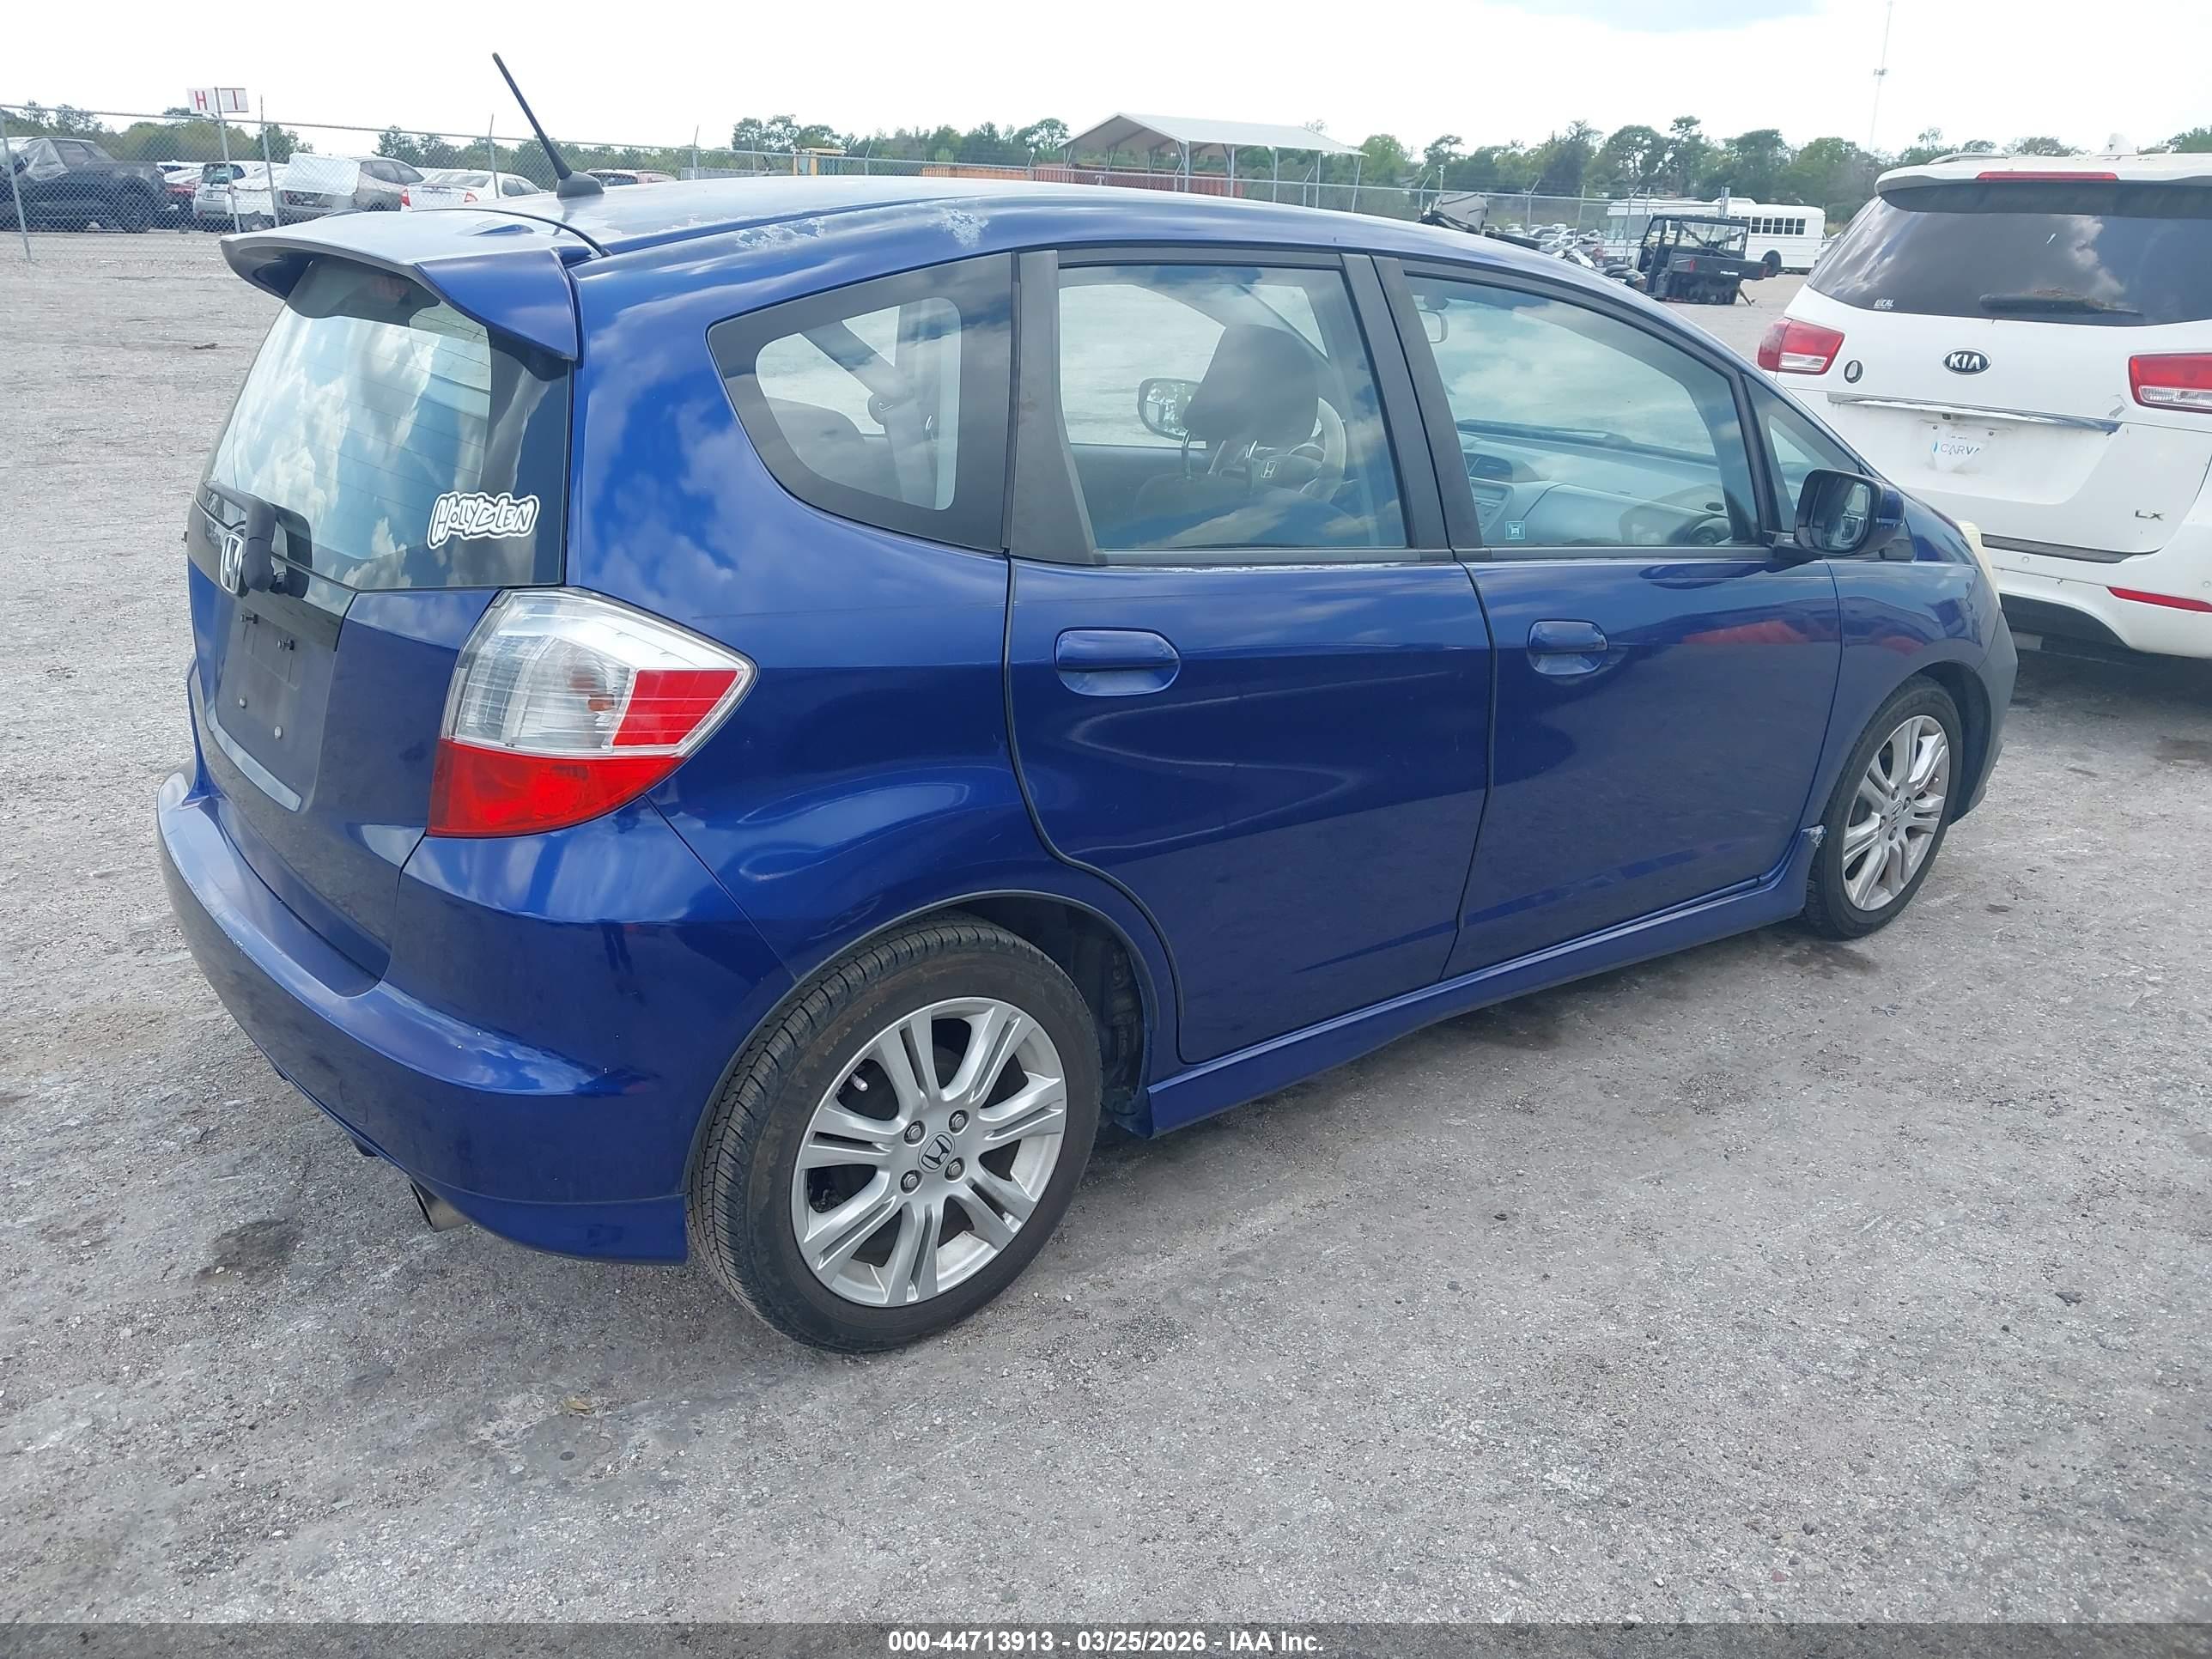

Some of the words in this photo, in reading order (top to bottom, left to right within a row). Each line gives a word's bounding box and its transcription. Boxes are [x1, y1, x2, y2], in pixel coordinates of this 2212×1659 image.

[194, 90, 208, 111] H
[1948, 353, 1982, 370] KIA
[2135, 509, 2165, 522] LX
